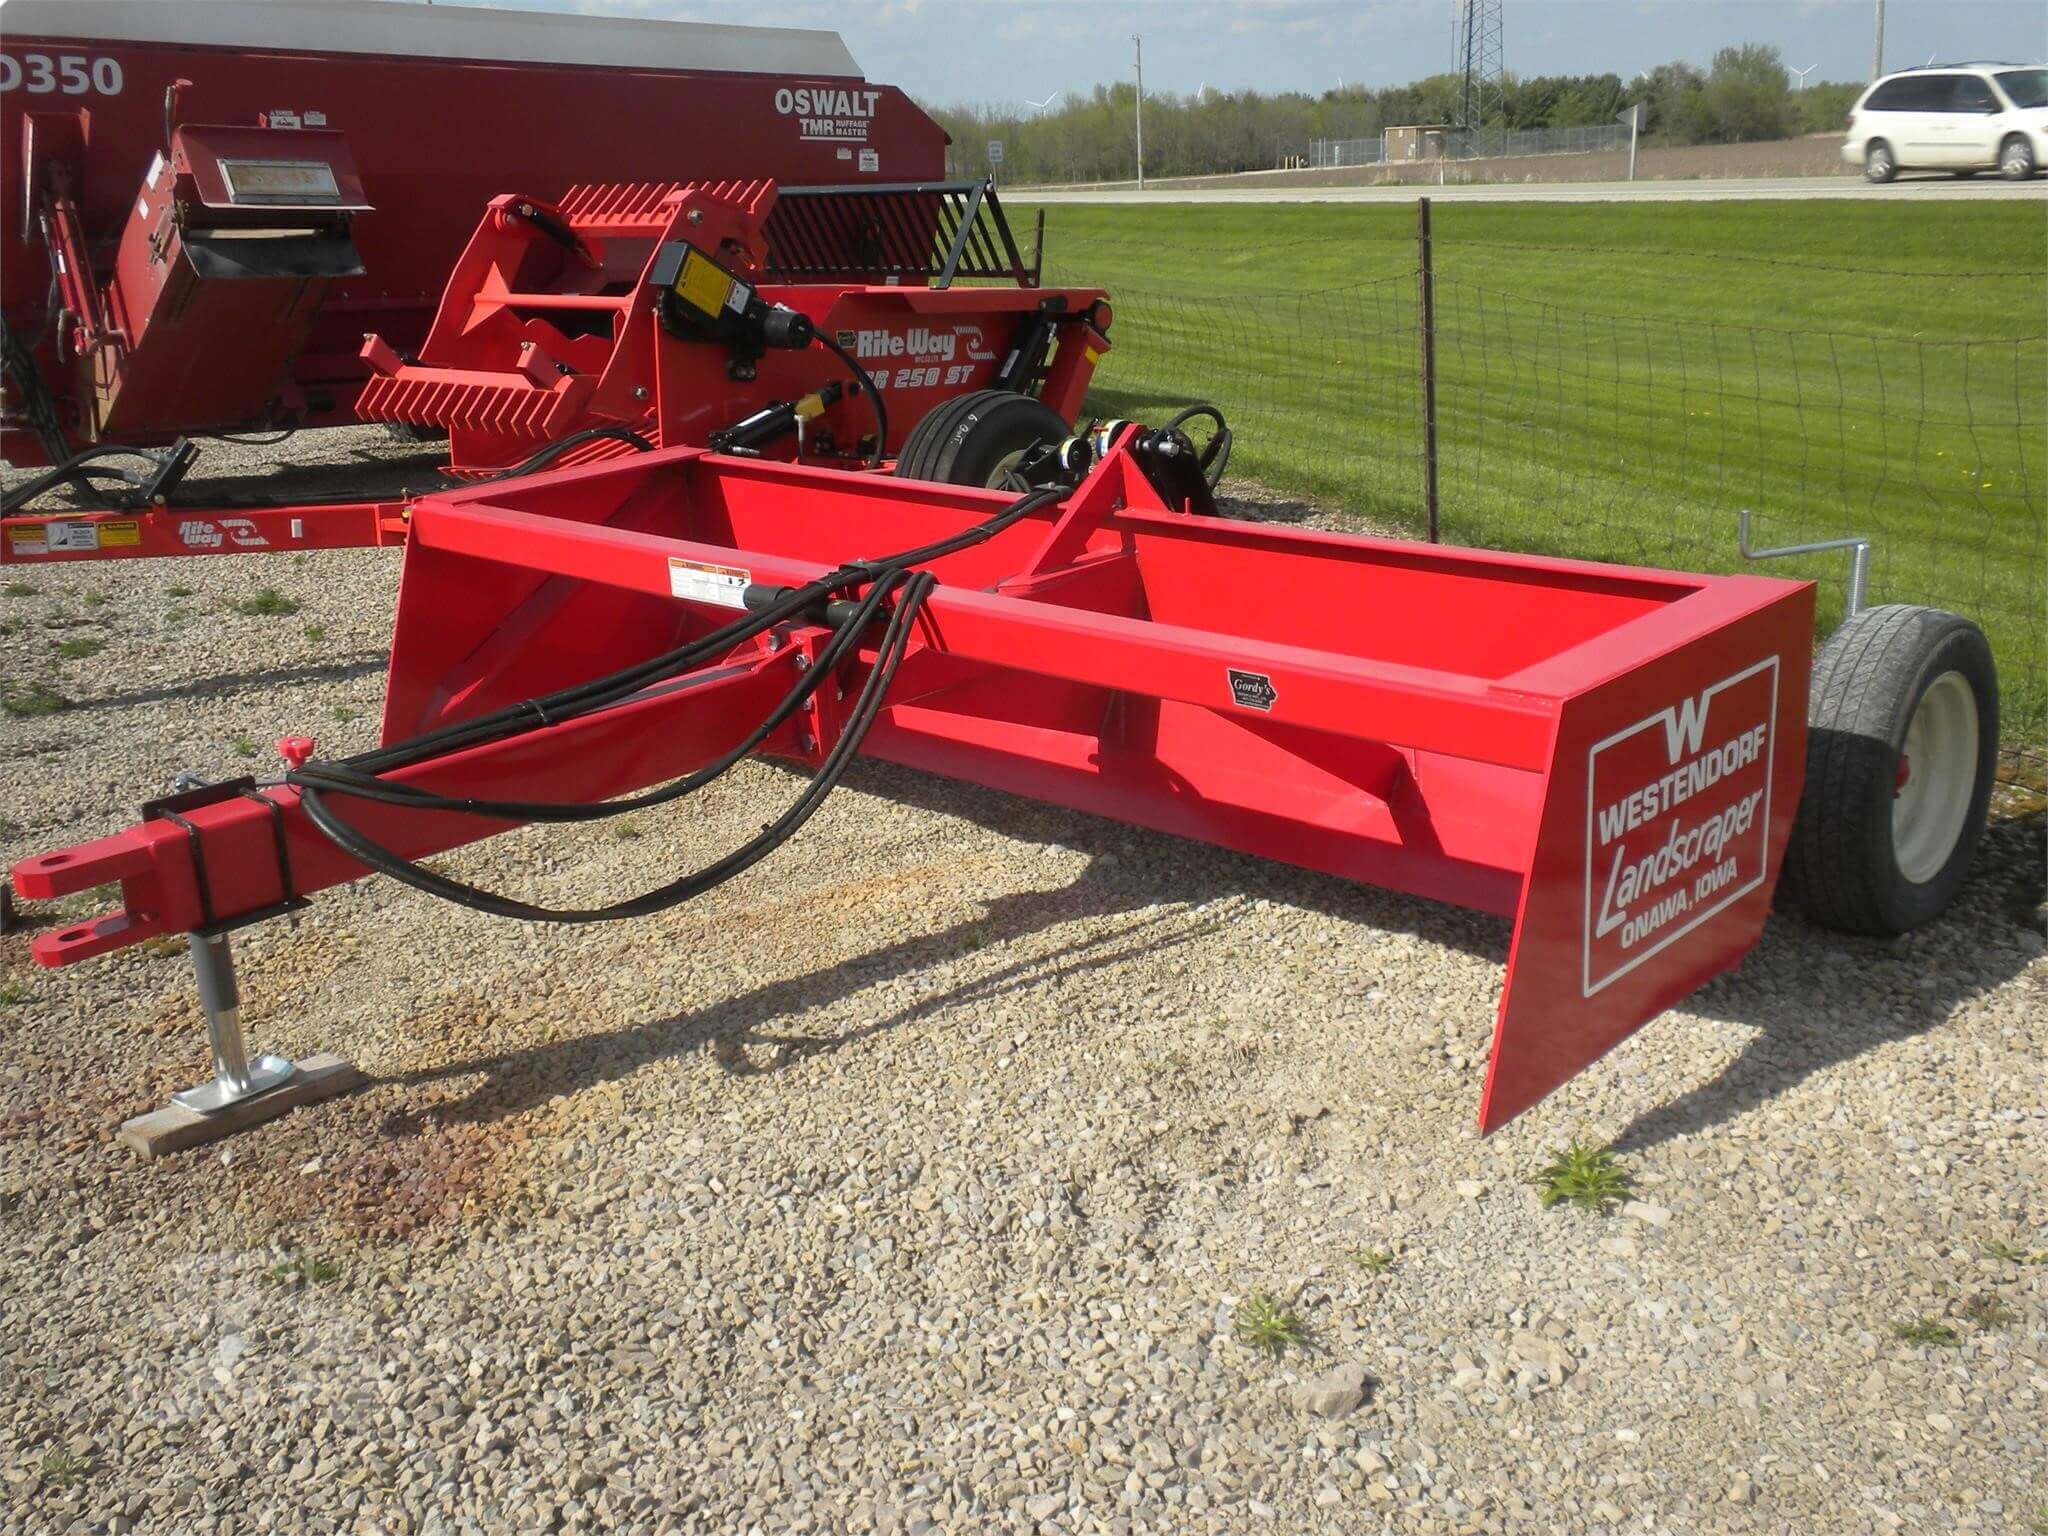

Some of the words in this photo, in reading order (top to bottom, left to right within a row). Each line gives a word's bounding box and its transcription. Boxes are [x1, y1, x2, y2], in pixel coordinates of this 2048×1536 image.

[775, 88, 879, 117] OSWALT
[800, 119, 834, 135] TMR
[836, 128, 867, 136] MASTER
[857, 330, 904, 357] Rite
[906, 328, 956, 361] Way
[865, 370, 889, 389] R
[894, 368, 940, 388] 250
[944, 365, 975, 385] ST
[179, 521, 214, 535] Rite
[1233, 678, 1271, 696] Gordy's
[1664, 694, 1710, 766] W
[1599, 723, 1767, 846] WESTENDORF
[1596, 788, 1763, 938] Landscraper
[1620, 887, 1693, 950] ONAWA,
[1696, 856, 1739, 901] IOWA
